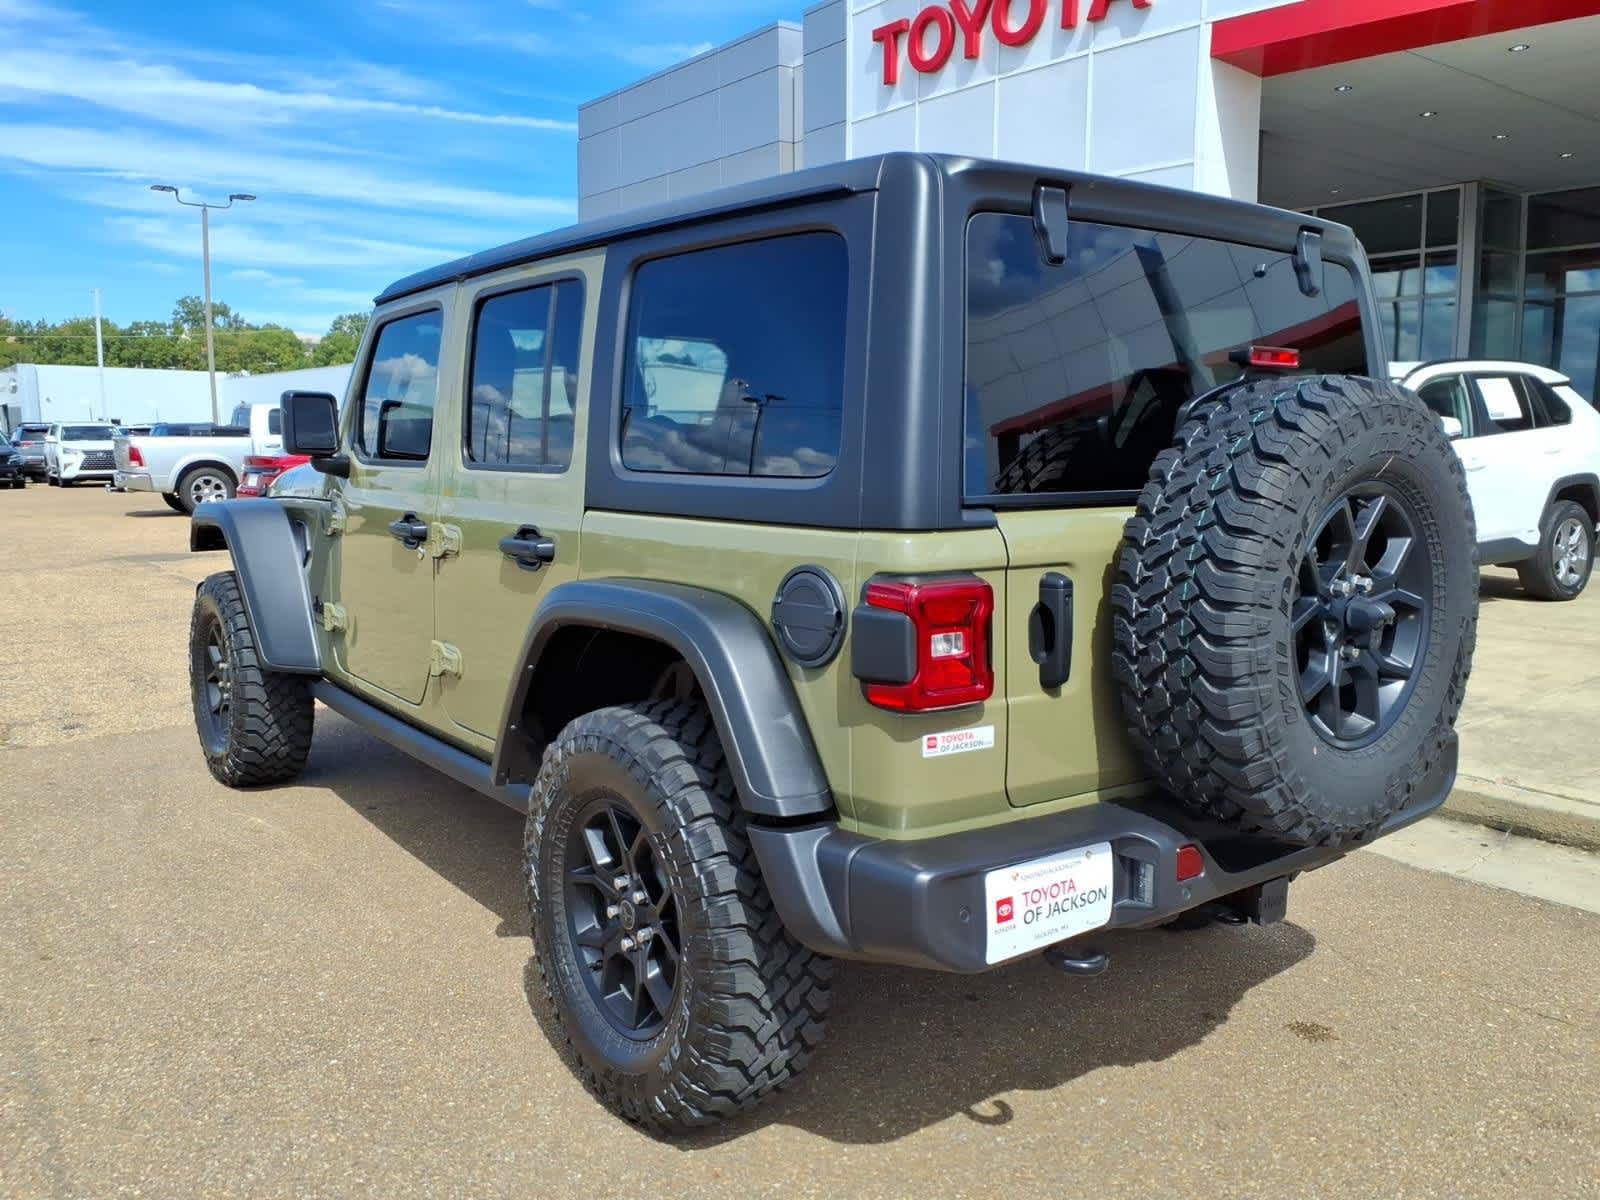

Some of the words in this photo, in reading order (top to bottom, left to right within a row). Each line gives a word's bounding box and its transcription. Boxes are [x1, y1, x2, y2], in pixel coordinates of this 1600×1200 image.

[940, 744, 951, 753] OF
[951, 739, 984, 752] JACKSON
[941, 731, 975, 744] TOYOTA
[1022, 878, 1077, 906] TOYOTA
[1023, 905, 1043, 925] OF
[1046, 885, 1108, 919] JACKSON
